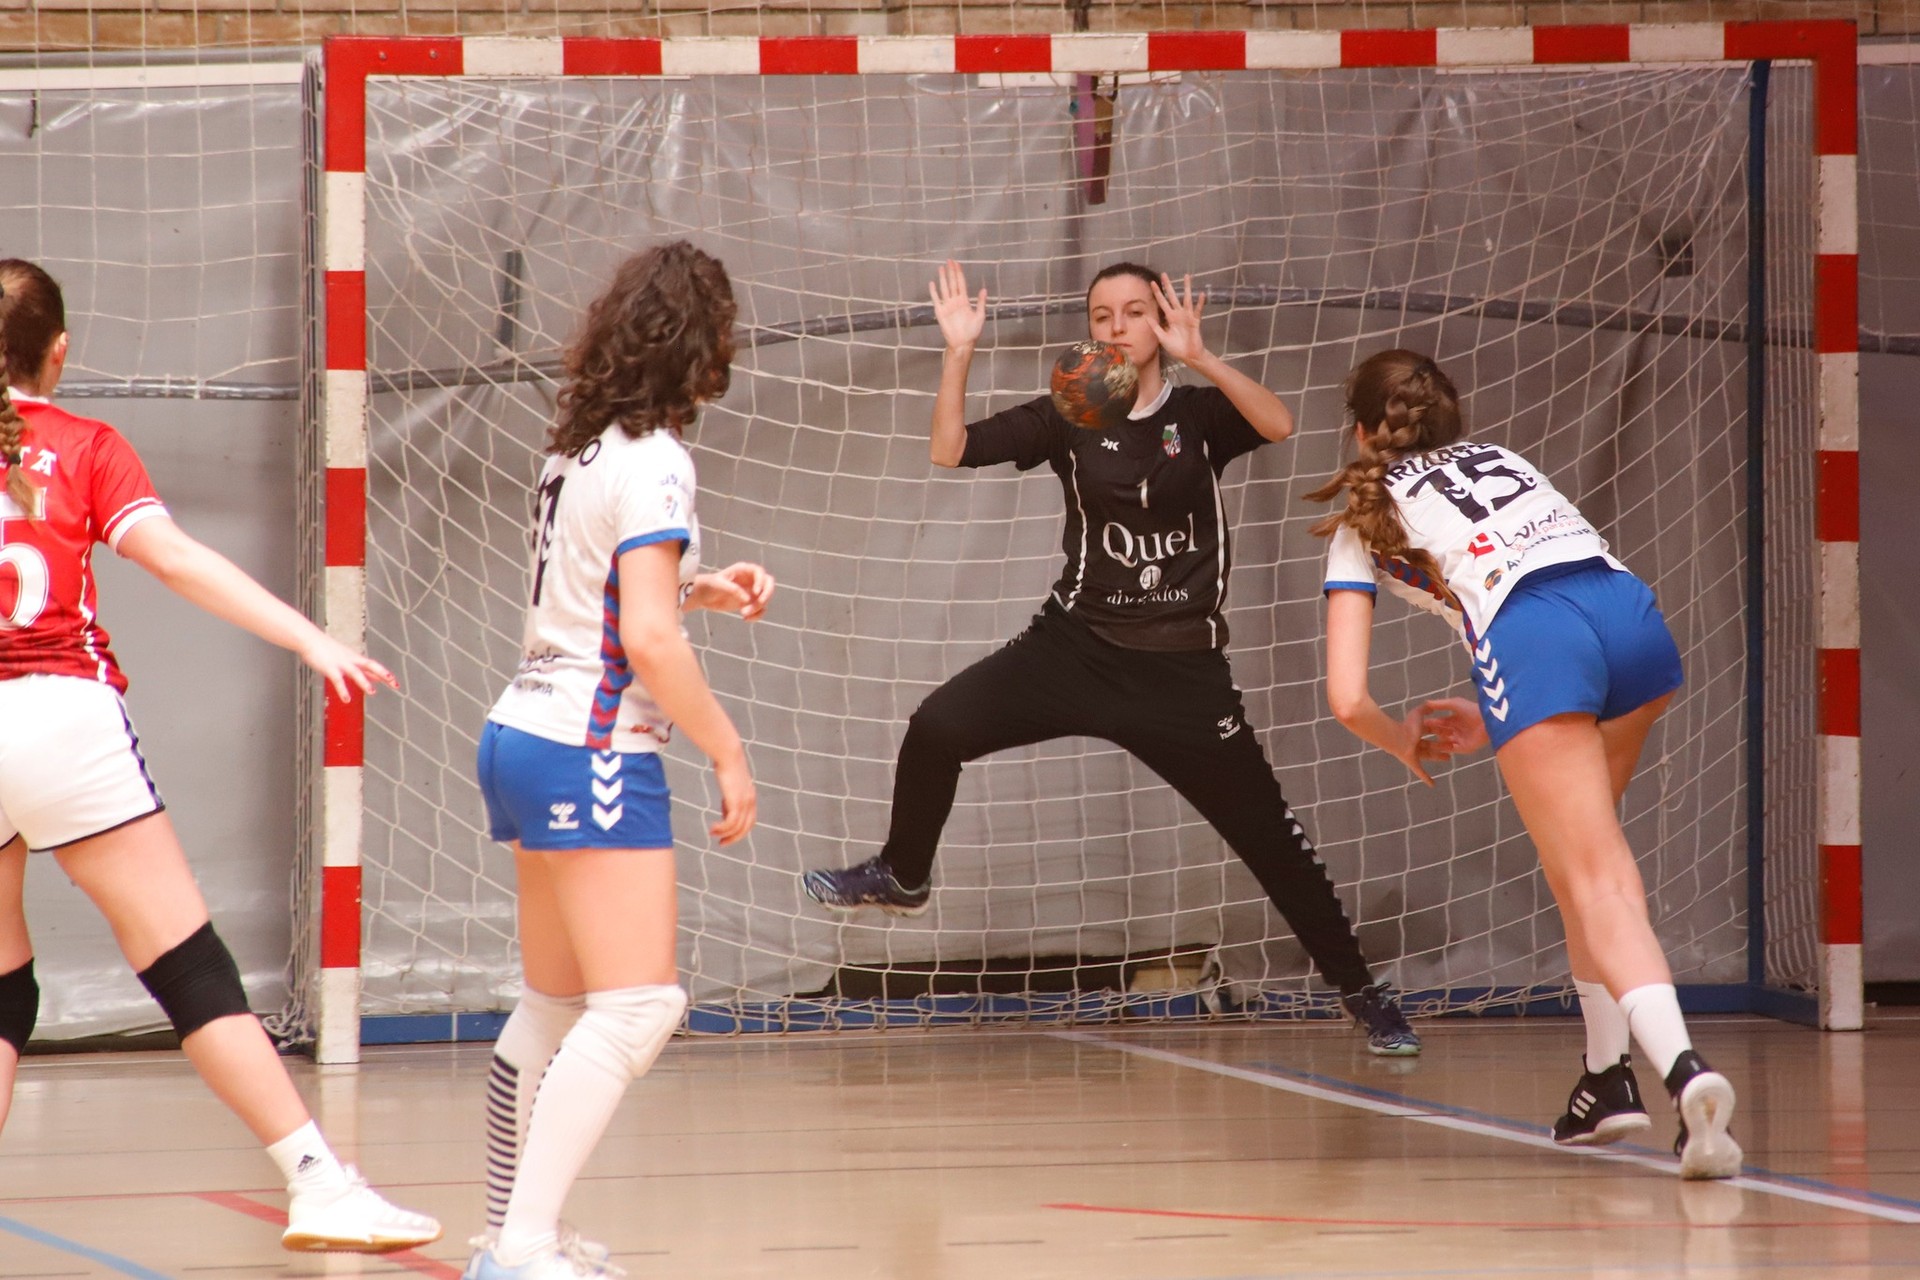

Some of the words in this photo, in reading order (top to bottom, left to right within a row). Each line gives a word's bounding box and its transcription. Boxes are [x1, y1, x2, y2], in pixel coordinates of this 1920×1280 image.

[1136, 478, 1149, 509] 1
[1405, 449, 1538, 524] 15
[1102, 512, 1199, 569] Quel
